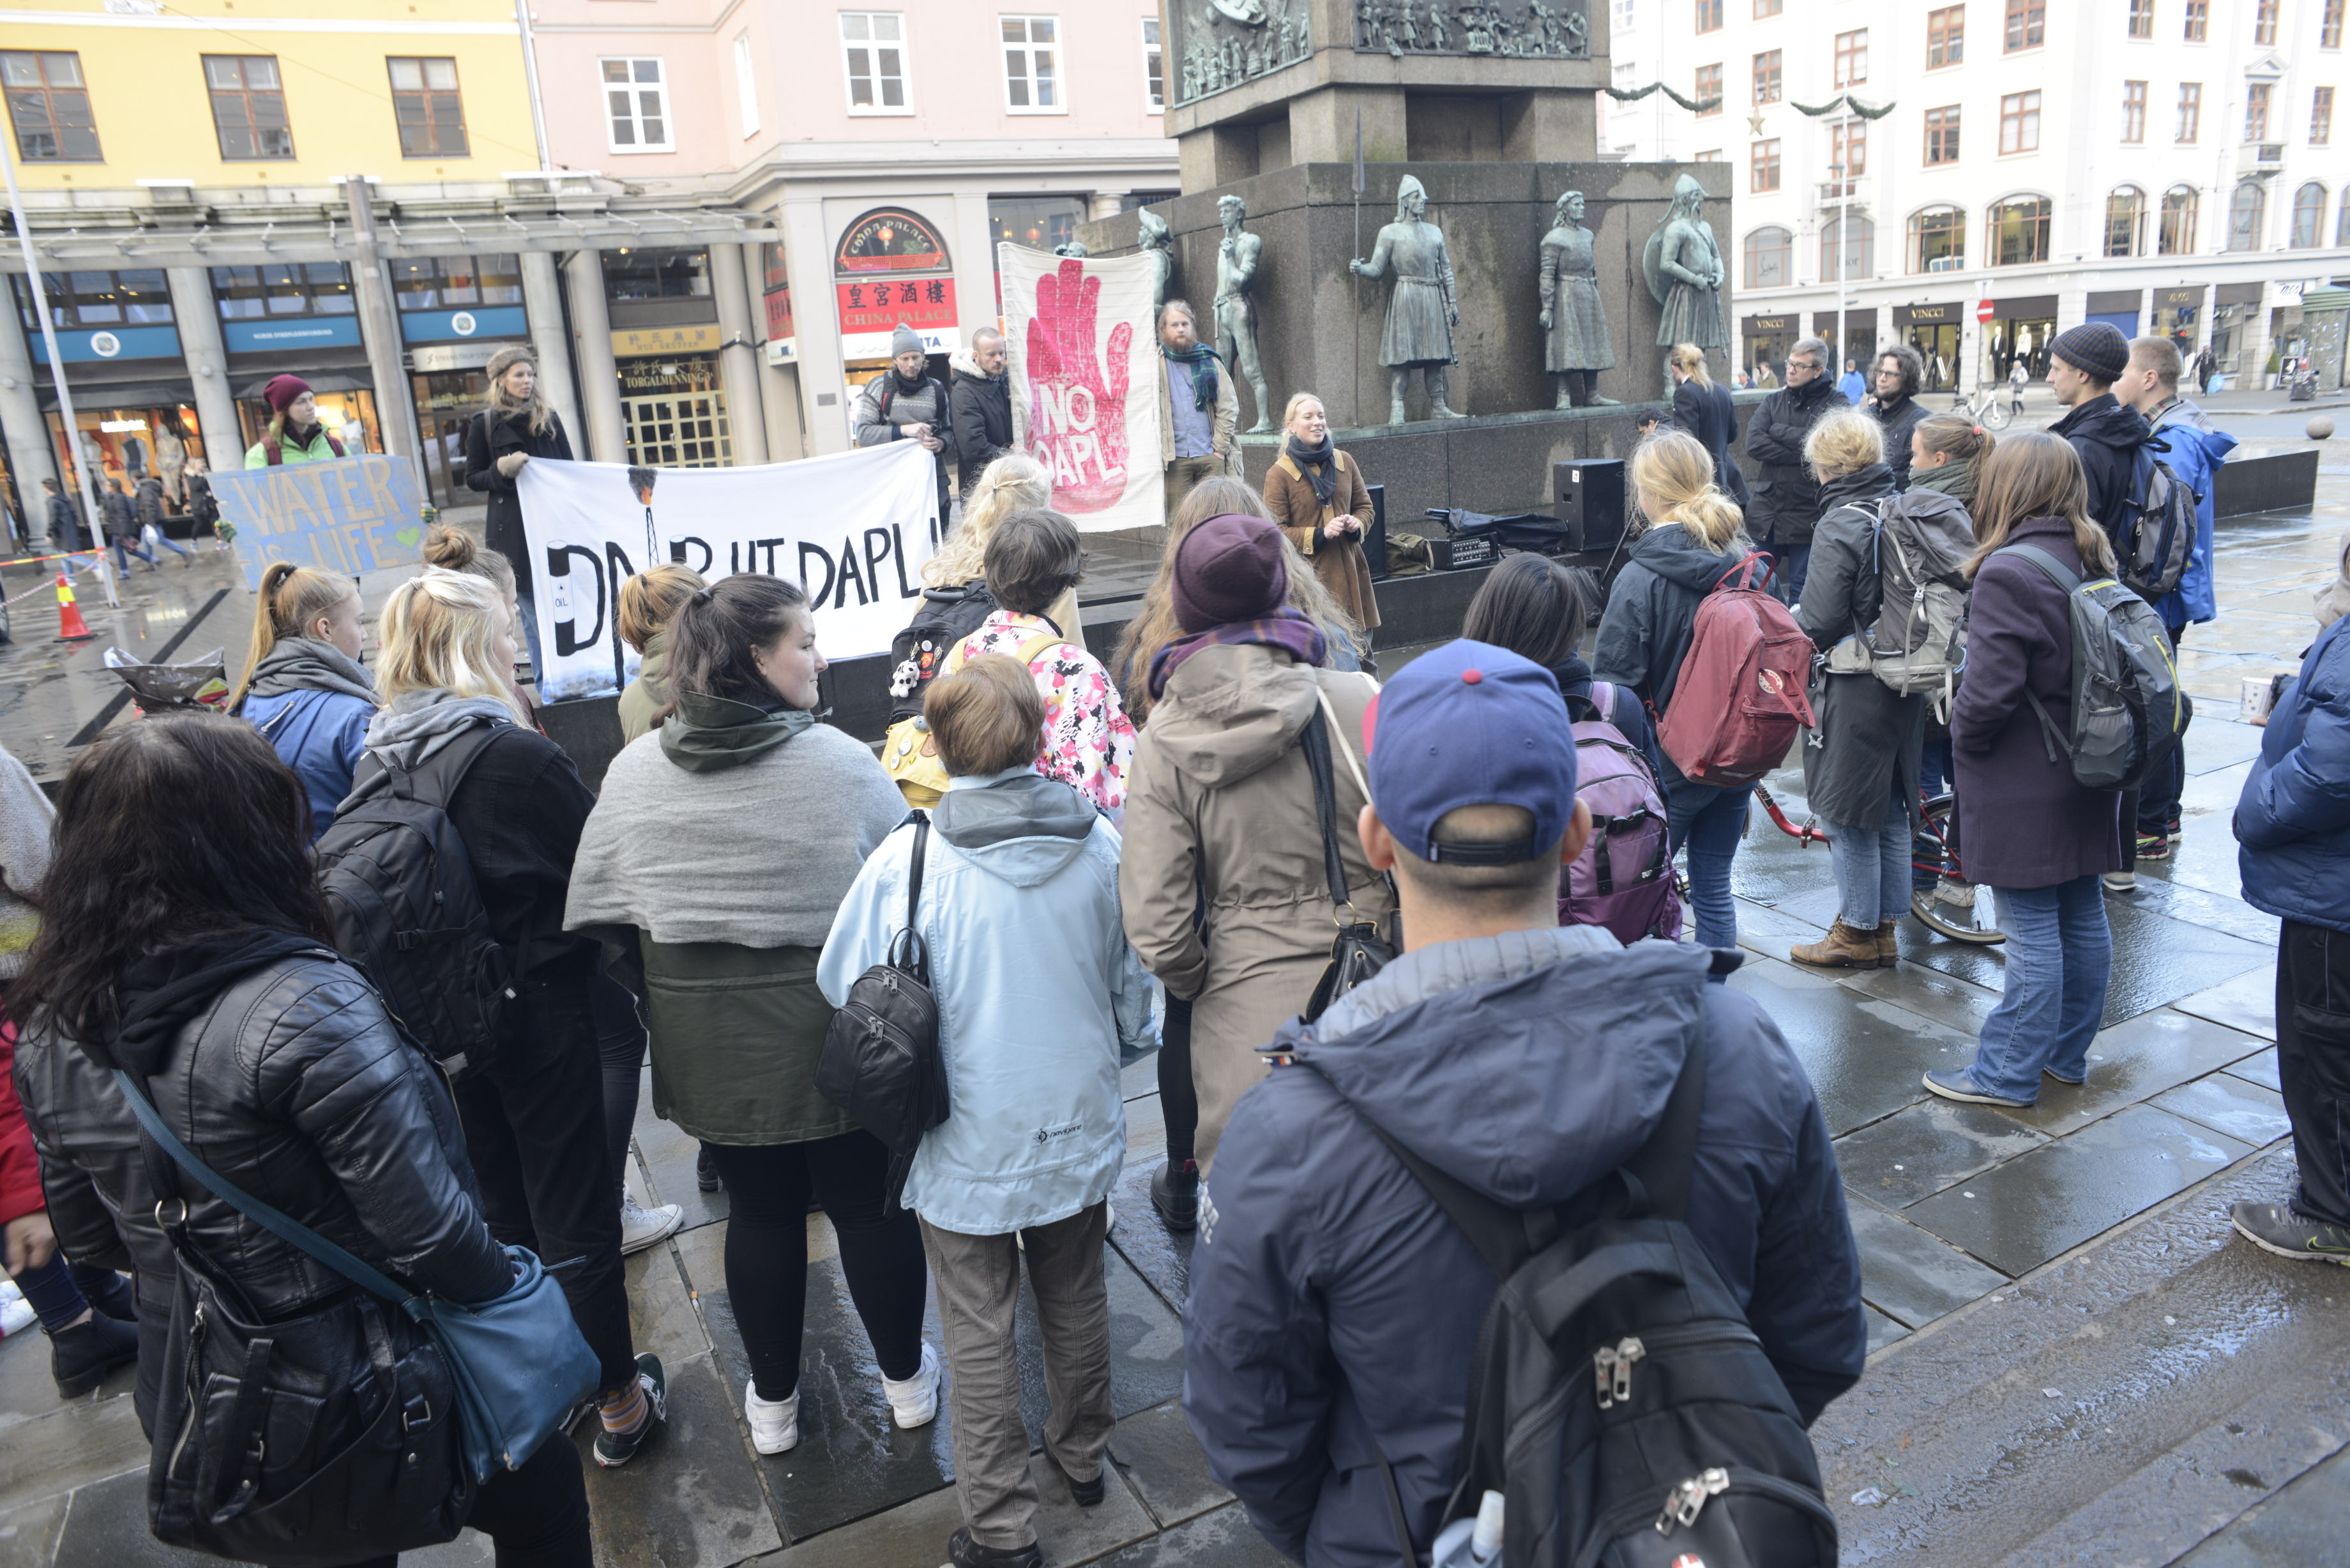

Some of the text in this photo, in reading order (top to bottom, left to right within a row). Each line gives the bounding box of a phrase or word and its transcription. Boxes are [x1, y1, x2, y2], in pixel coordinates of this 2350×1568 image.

[847, 280, 946, 309] 皇宮酒樓
[845, 309, 953, 326] CHINA PALACE
[1757, 319, 1784, 328] VINCCI
[1911, 308, 1944, 319] VINCCI
[625, 372, 704, 389] TORGALMENNING
[1038, 384, 1095, 435] NO
[1033, 430, 1126, 487] DAPL
[231, 456, 401, 536] WATER
[307, 519, 398, 574] LIFE
[555, 598, 568, 607] OIL
